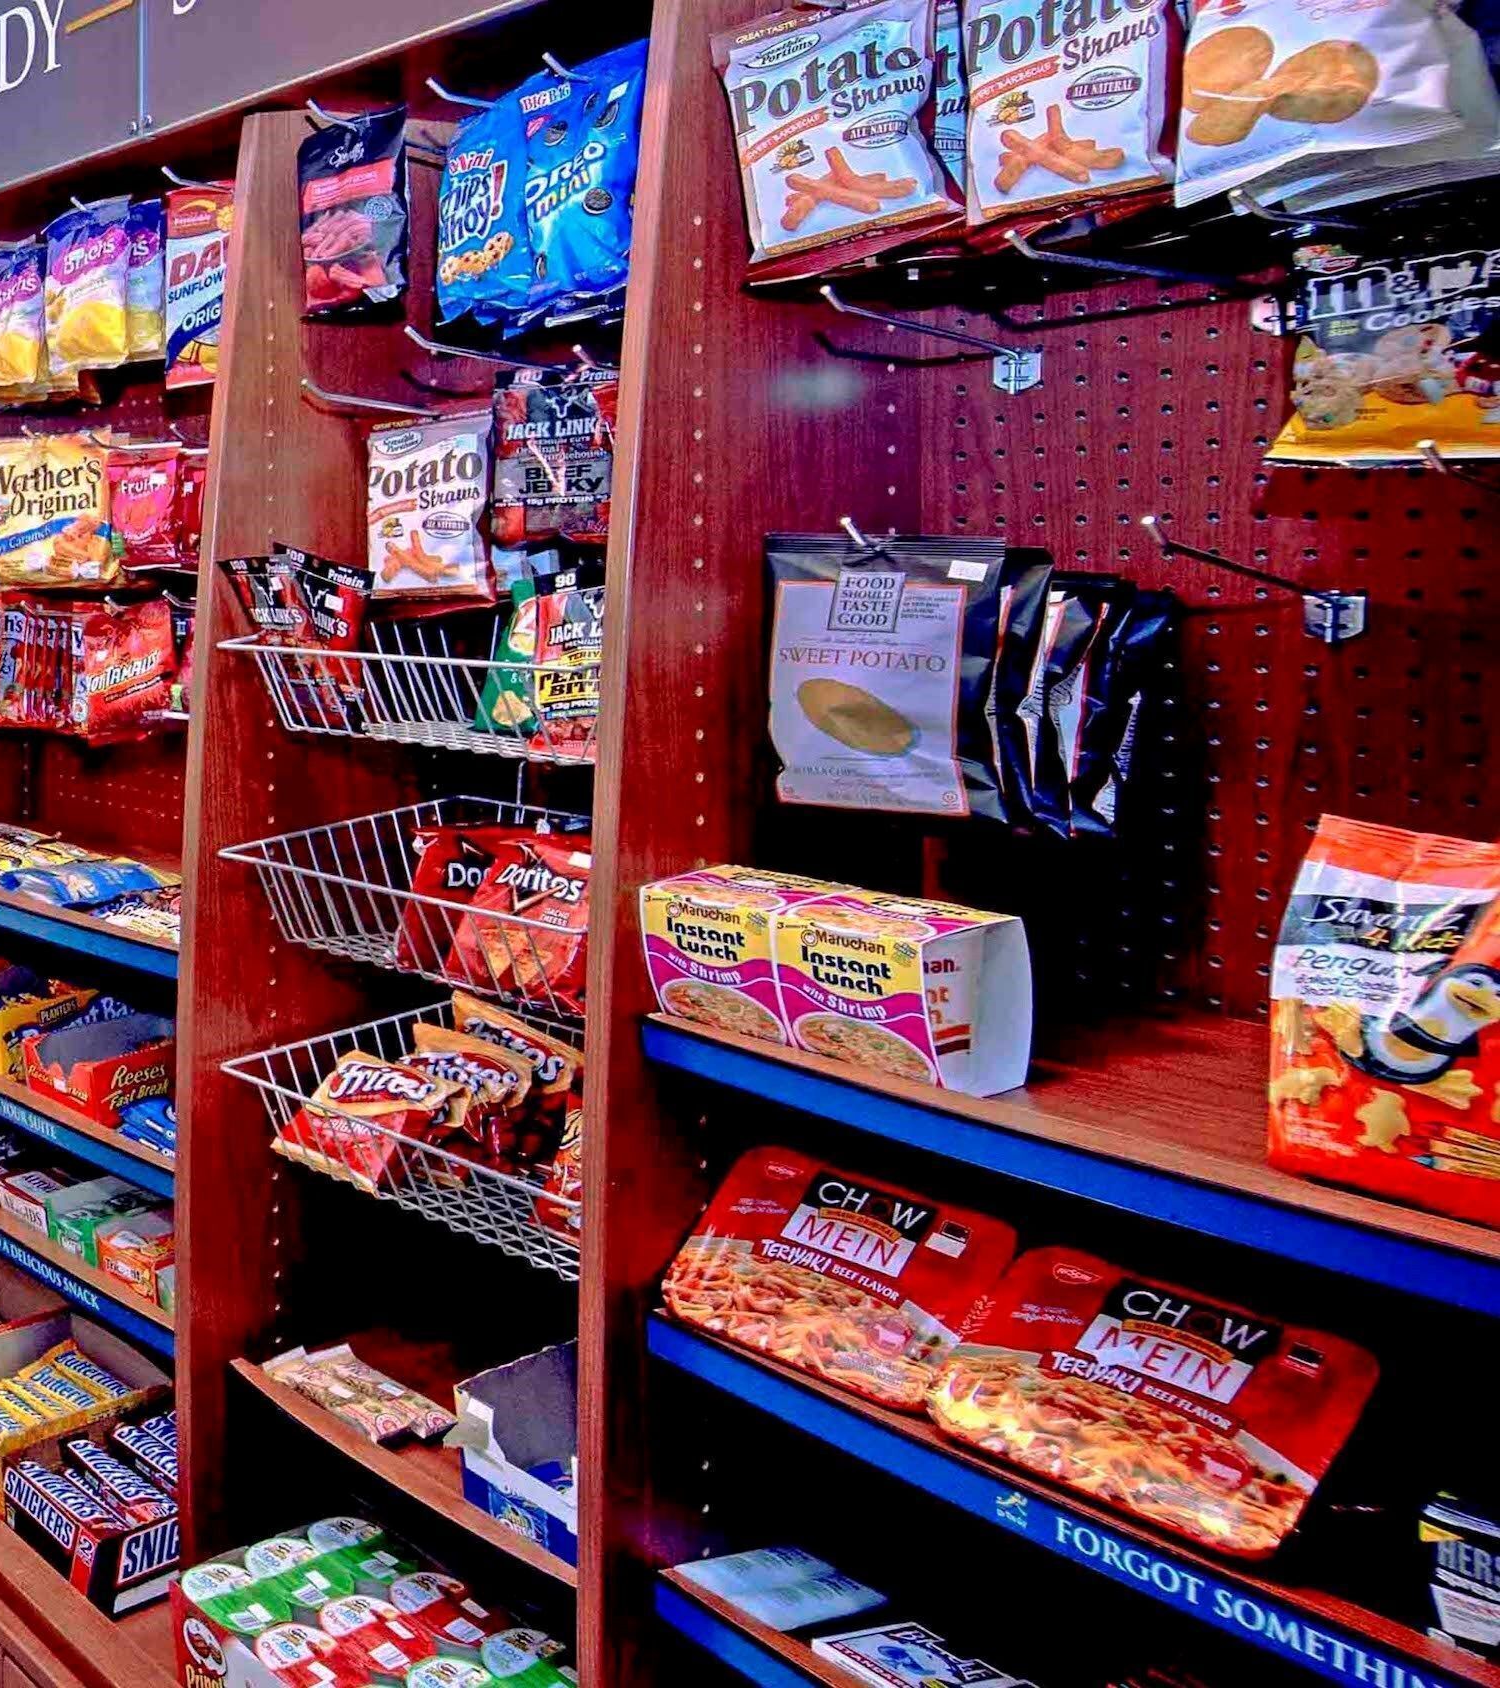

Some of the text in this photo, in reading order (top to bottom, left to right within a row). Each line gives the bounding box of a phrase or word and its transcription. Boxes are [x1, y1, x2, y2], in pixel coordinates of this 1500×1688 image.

[1063, 15, 1160, 72] Straws
[731, 40, 923, 135] Potato
[831, 74, 926, 119] Straws
[1073, 78, 1134, 97] ALL NATURAL
[525, 141, 605, 206] OREO
[167, 271, 225, 305] SUNFLOW
[181, 307, 221, 332] ORIG
[506, 420, 551, 440] JACK
[369, 450, 483, 502] Potato
[525, 463, 592, 480] BEF
[10, 488, 97, 520] Original
[419, 485, 480, 511] Straws
[327, 569, 365, 589] Protein
[555, 573, 576, 588] 90
[841, 589, 894, 600] SHOULD
[844, 576, 896, 590] FOOD
[837, 612, 888, 627] GOOD
[840, 600, 892, 613] TASTE
[549, 622, 587, 645] JACK
[778, 646, 947, 673] SWEET POTATO
[550, 680, 600, 697] BIT
[571, 699, 600, 710] PROT
[494, 862, 586, 901] Doritos
[678, 900, 742, 925] Maruchan
[666, 916, 745, 948] Instant
[815, 928, 887, 956] Maruchan
[1360, 927, 1390, 947] 4
[676, 934, 740, 964] Lunch
[800, 945, 892, 980] Instant
[667, 952, 743, 986] with Shrimp
[812, 964, 885, 996] Lunch
[802, 983, 888, 1022] with Shrimp
[137, 1078, 170, 1098] Break
[328, 1062, 437, 1100] Fritos
[26, 1114, 57, 1140] SUITE
[818, 1181, 928, 1230] CHOW
[796, 1213, 901, 1268] MEIN
[0, 1238, 10, 1255] A
[9, 1243, 63, 1288] DELICIOUS
[62, 1276, 100, 1311] SNACK
[761, 1238, 901, 1302] TERIYAKI BEEF FLAVOR
[1122, 1290, 1268, 1351] CHOW
[1096, 1326, 1232, 1392] MEIN
[1051, 1351, 1233, 1431] TERIYAKI BEEF FLAVOR
[117, 1426, 178, 1477] SNICKE
[73, 1441, 146, 1499] SNICKERS
[19, 1460, 99, 1520] SNICKERS
[4, 1469, 75, 1548] SNICKERS
[122, 1522, 179, 1580] SNIC
[1055, 1515, 1205, 1606] FORGOT
